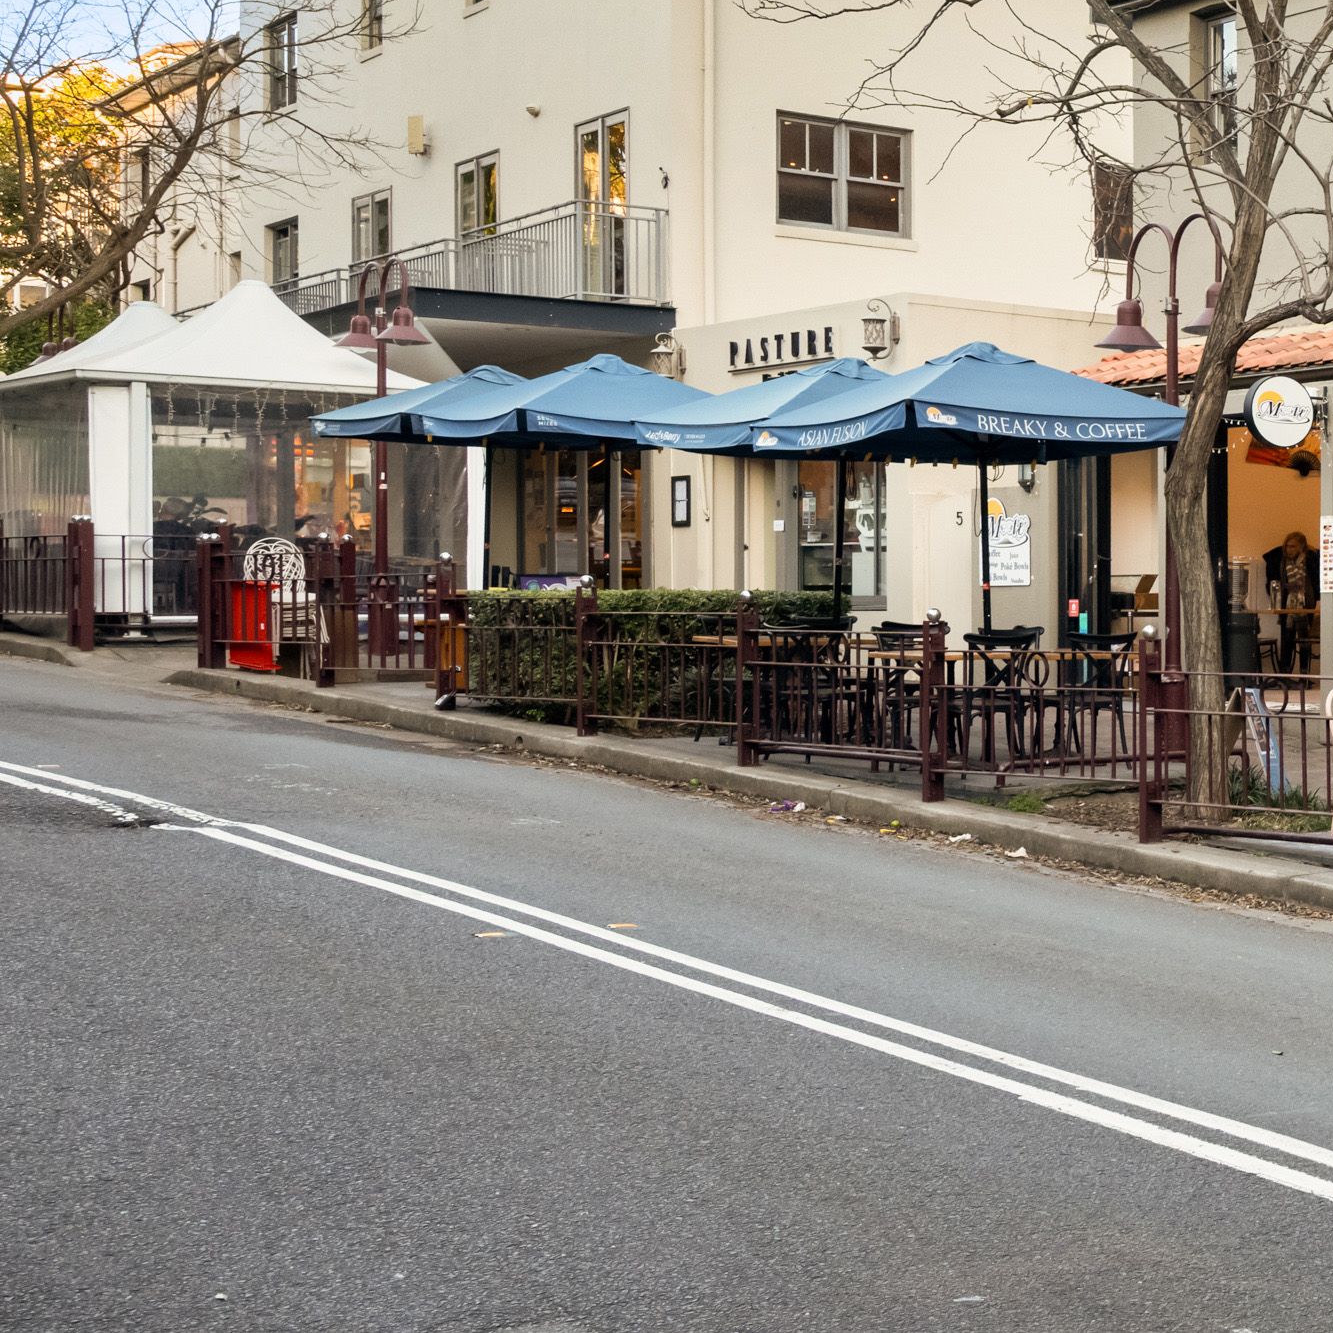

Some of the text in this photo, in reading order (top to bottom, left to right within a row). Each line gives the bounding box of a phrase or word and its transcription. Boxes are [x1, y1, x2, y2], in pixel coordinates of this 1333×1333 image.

[729, 327, 833, 366] PASTURE
[798, 419, 868, 447] ASIAN FUSION
[977, 415, 1047, 436] BREAKY
[1055, 422, 1069, 438] &
[1076, 423, 1148, 440] COFFEE
[956, 511, 964, 526] 5
